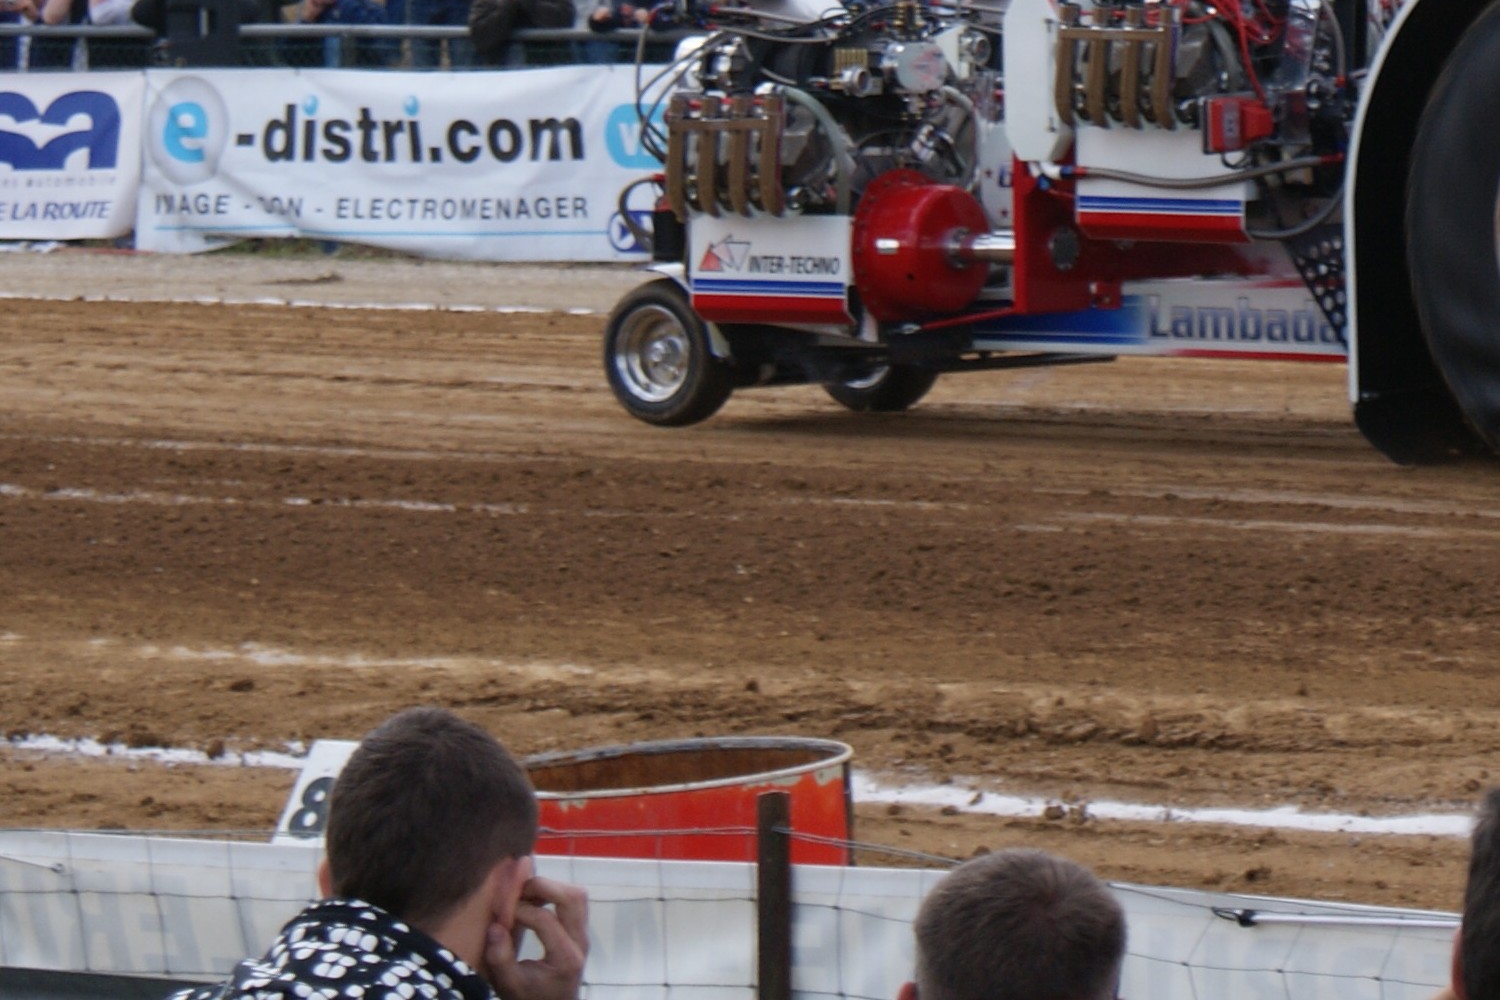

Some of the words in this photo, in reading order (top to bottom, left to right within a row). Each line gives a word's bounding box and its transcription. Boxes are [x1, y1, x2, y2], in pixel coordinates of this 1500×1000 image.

[10, 202, 38, 221] LA
[42, 200, 112, 220] ROUTE
[337, 197, 588, 220] ELECTROMENAGER
[748, 255, 840, 275] INTER-TECHNO
